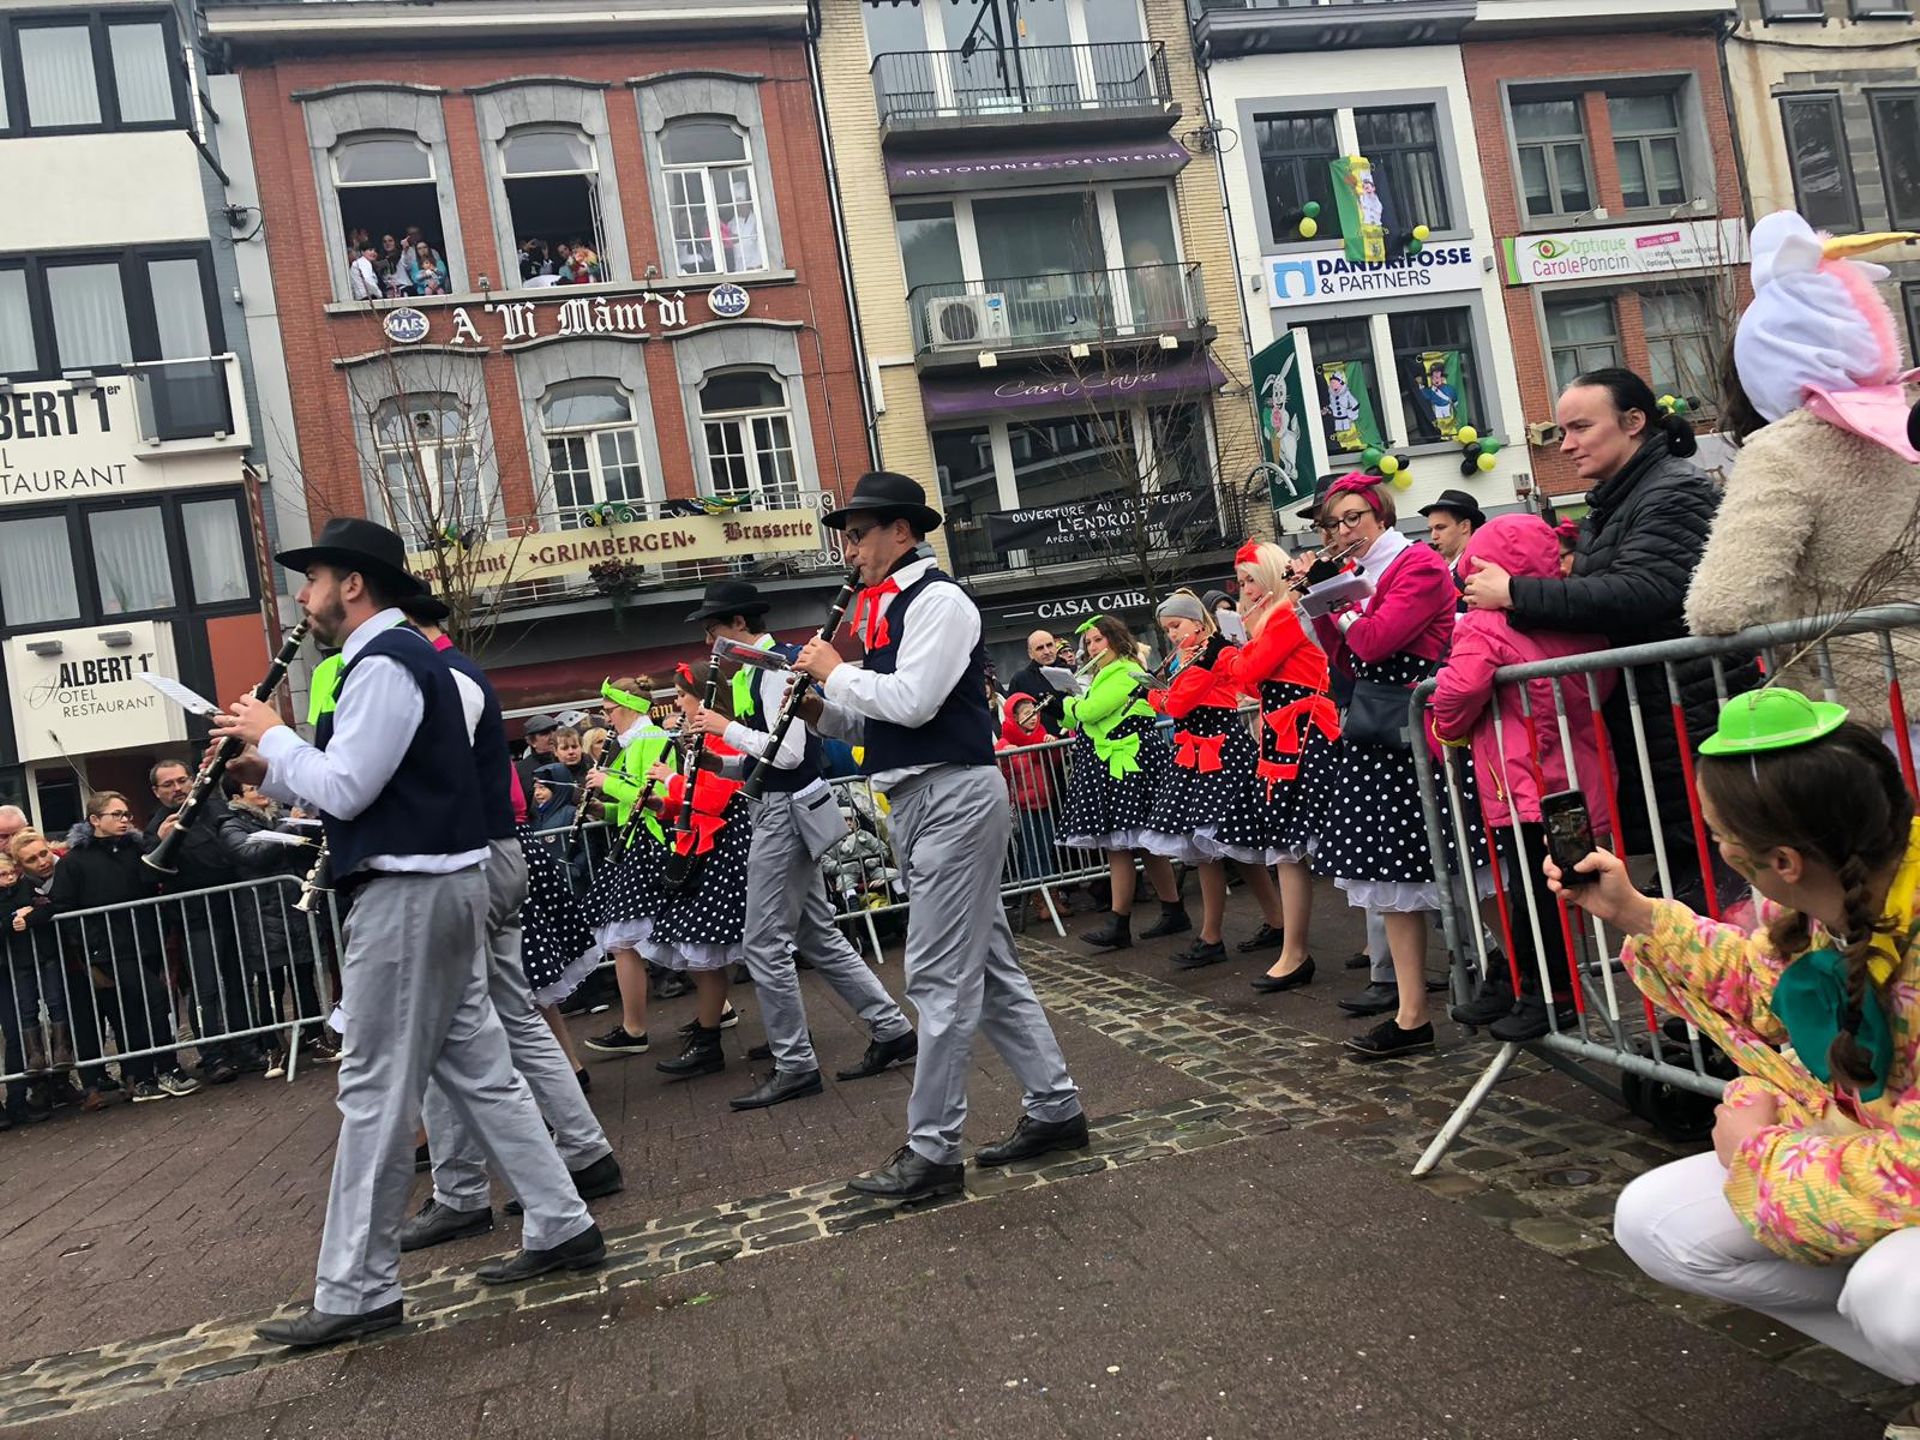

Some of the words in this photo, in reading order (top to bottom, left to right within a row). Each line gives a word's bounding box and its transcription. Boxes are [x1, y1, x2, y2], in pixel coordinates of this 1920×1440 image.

[905, 161, 1042, 177] RISTORANTE
[1064, 152, 1181, 166] GELATERIA
[1570, 238, 1627, 257] Optique
[1320, 278, 1335, 295] &
[1339, 269, 1432, 293] PARTNERS
[711, 292, 747, 307] MAES
[389, 317, 427, 332] MAES
[449, 306, 484, 345] A
[994, 380, 1080, 398] Casa
[1012, 504, 1086, 523] OUVERTURE
[1096, 501, 1112, 513] AU
[412, 553, 507, 583] estaurant
[538, 530, 688, 565] GRIMBERGEN
[722, 519, 814, 544] Brasserie
[1037, 598, 1094, 619] CASA
[58, 654, 133, 689] ALBERT
[63, 695, 156, 718] RESTAURANT
